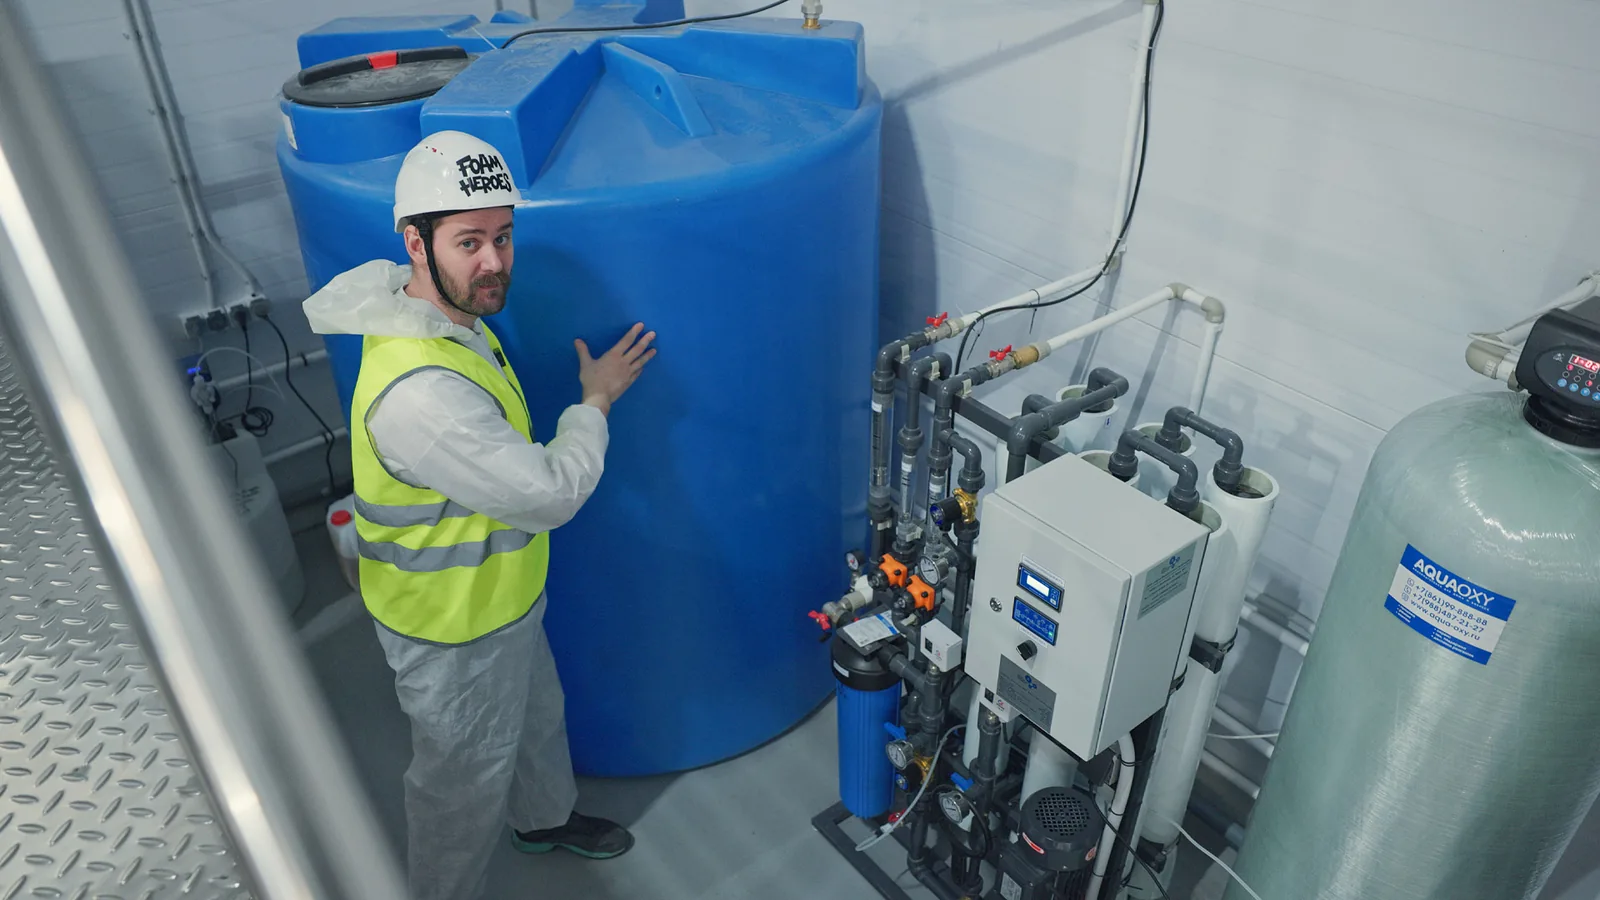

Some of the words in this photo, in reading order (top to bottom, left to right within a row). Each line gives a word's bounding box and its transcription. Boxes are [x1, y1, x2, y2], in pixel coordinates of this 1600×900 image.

[456, 153, 503, 177] FOAM
[459, 172, 512, 197] HEROES
[1414, 558, 1494, 606] AQUAOXY
[1410, 600, 1480, 641] www.aqua-oxy.ru
